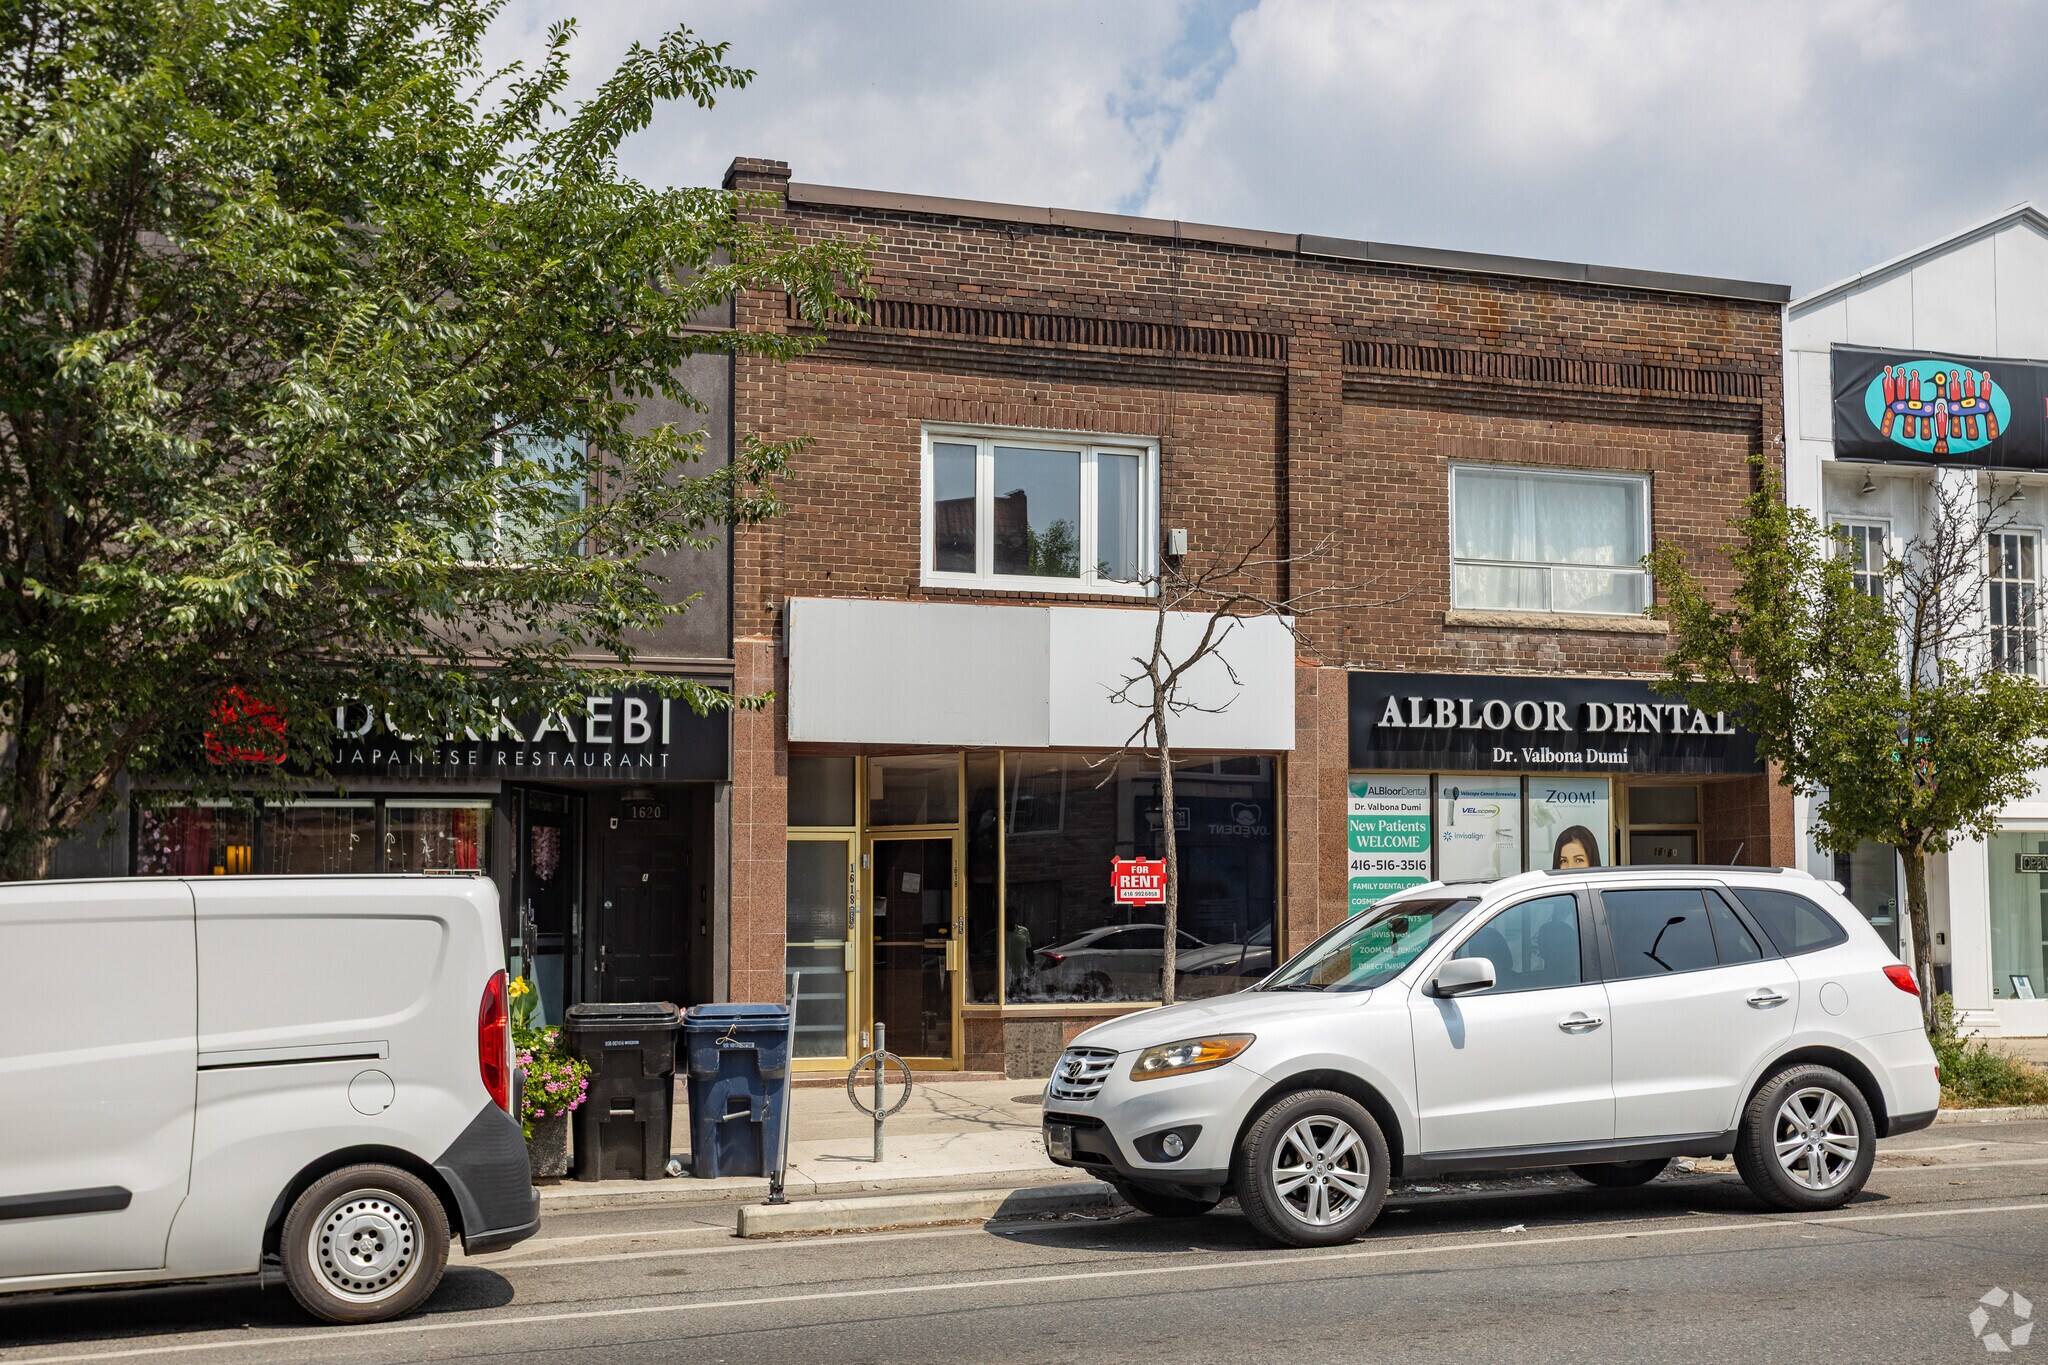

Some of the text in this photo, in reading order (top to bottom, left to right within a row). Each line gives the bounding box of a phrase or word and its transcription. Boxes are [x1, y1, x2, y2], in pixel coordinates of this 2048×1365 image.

[1377, 695, 1736, 735] ALBLOOR DENTAL
[336, 749, 669, 767] JAPANESE RESTAURANT
[1493, 747, 1629, 764] Dr. Valbona Dumi
[1368, 786, 1427, 796] ALBloorDental
[632, 806, 661, 819] 1620
[1354, 803, 1422, 811] Dr. Valbona Dumi
[1350, 820, 1427, 832] New Patients
[1356, 835, 1420, 848] WELCOME
[1454, 832, 1484, 841] invisalign
[1131, 865, 1149, 874] FOR
[1350, 859, 1427, 871] 416-516-3516
[1120, 875, 1160, 888] RENT
[1352, 882, 1378, 890] FAMILY
[1378, 882, 1406, 890] DENTAL
